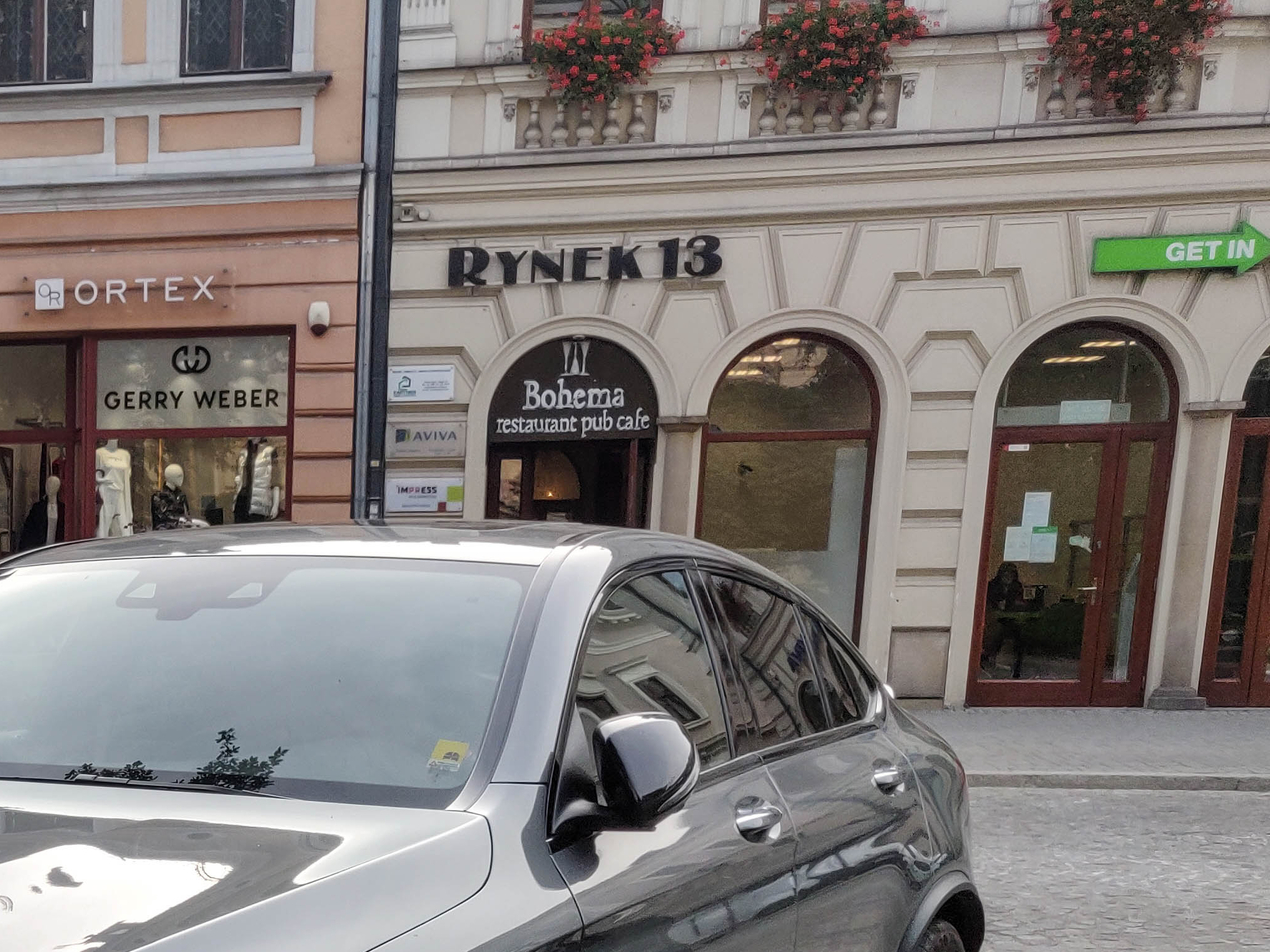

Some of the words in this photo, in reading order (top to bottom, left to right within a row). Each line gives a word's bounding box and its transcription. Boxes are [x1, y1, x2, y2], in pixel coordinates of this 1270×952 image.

[448, 245, 643, 287] RYNEK
[658, 234, 723, 280] 13
[1165, 241, 1222, 262] GET
[1227, 239, 1256, 260] IN
[74, 275, 215, 305] ORTEX
[104, 390, 184, 411] GERRY
[194, 388, 279, 409] WEBER
[522, 379, 626, 411] Bohema
[496, 413, 577, 434] restaurant
[581, 408, 613, 438] pub
[616, 407, 650, 432] cafe
[413, 431, 457, 441] AVIVA
[396, 485, 437, 494] IMPRESS
